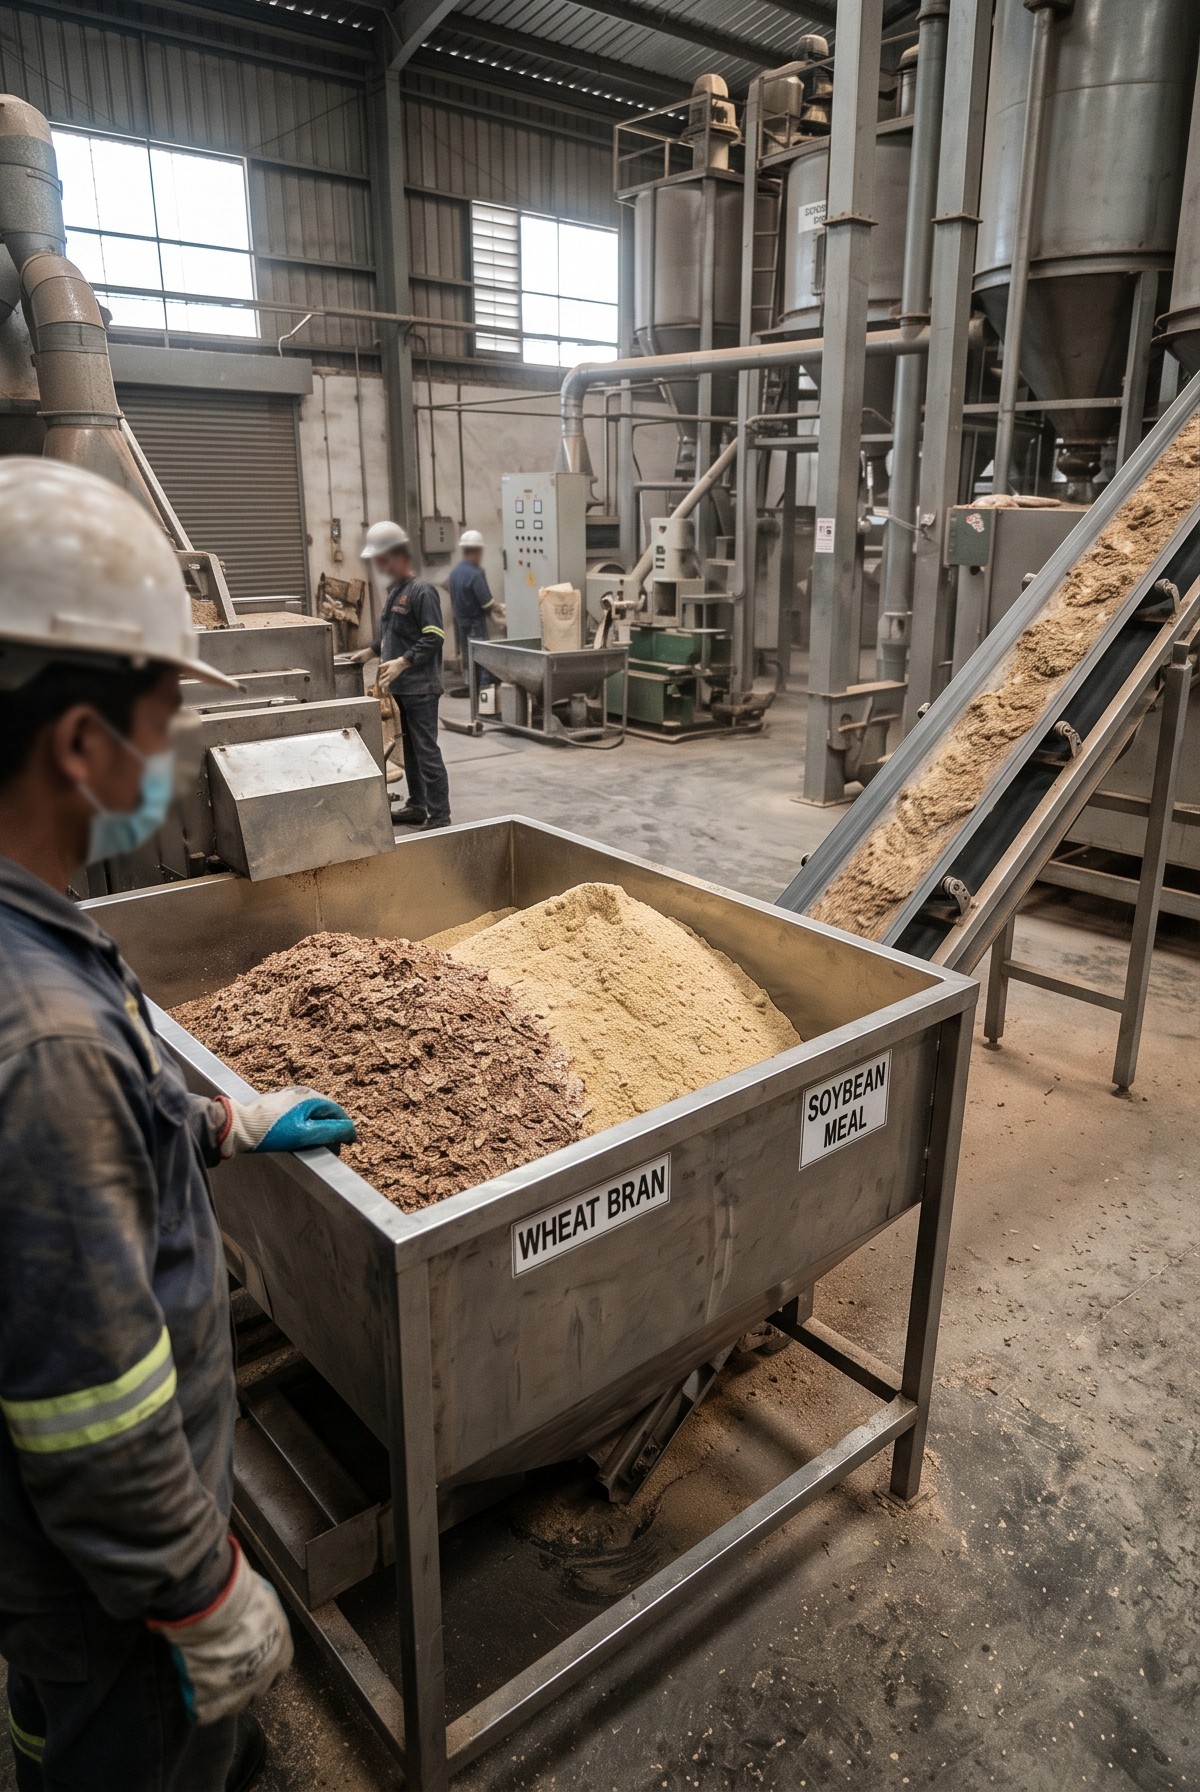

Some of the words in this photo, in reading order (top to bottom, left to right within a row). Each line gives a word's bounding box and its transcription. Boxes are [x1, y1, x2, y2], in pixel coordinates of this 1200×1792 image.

[807, 1061, 886, 1122] SOYBEAN
[823, 1105, 867, 1149] MEAL
[518, 1196, 600, 1260] WHEAT
[607, 1165, 666, 1219] BRAN
